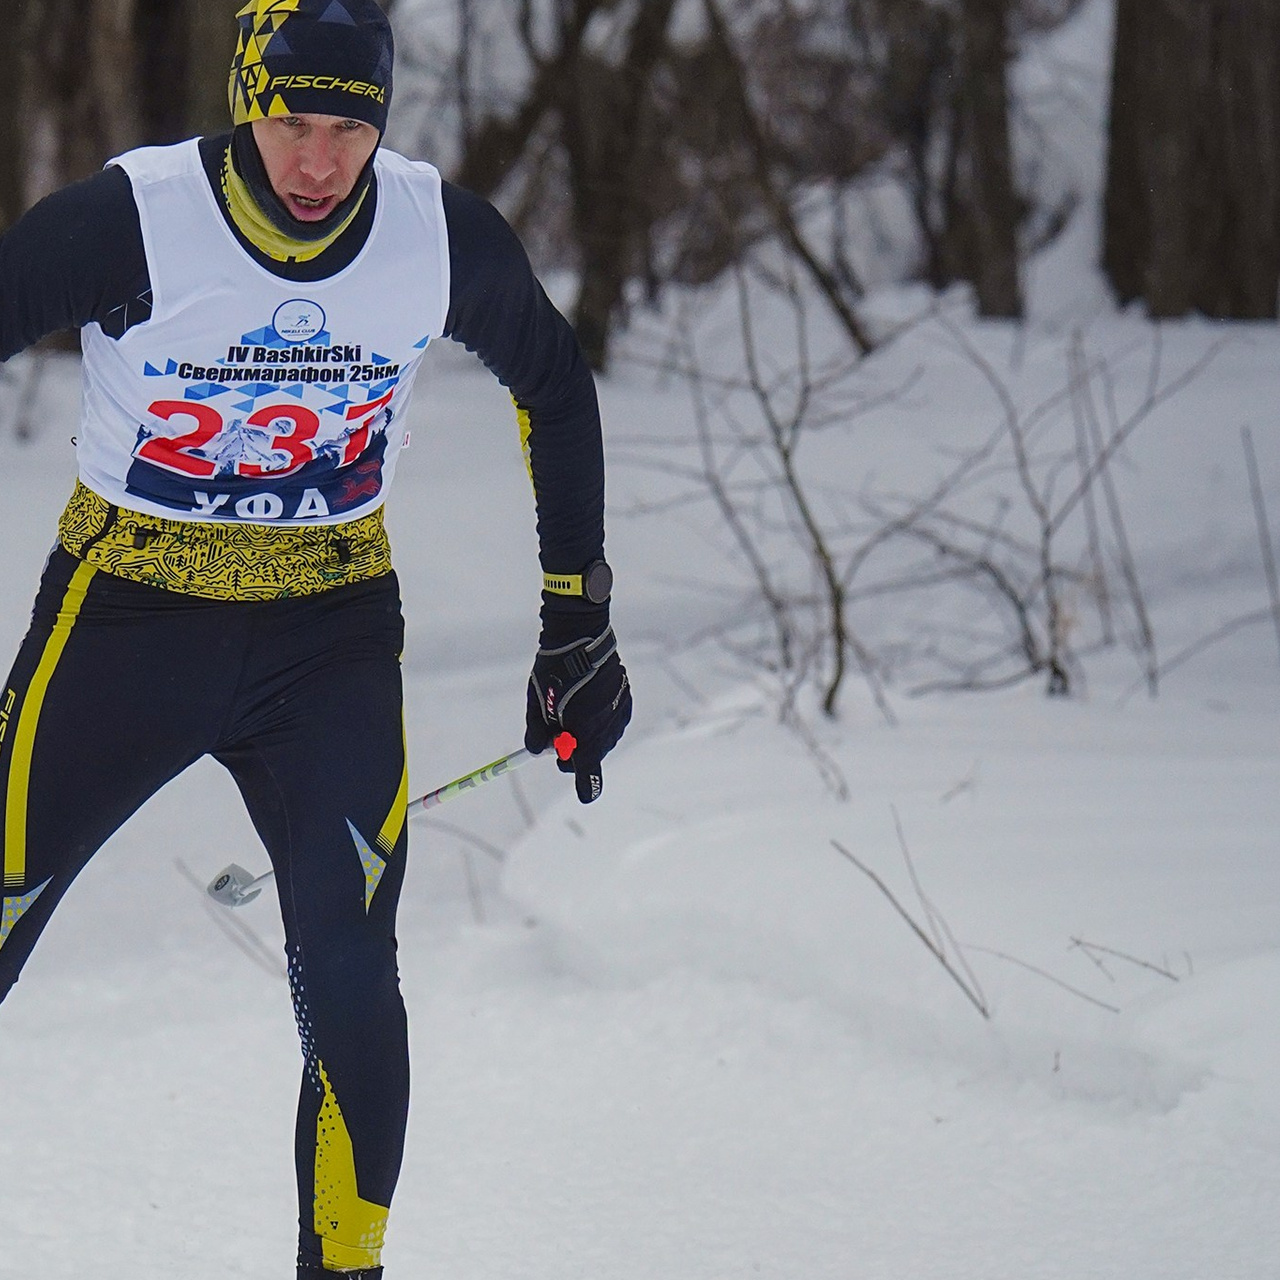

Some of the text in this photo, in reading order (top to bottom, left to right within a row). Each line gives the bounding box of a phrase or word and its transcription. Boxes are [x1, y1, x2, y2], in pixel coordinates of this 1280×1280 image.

[270, 75, 380, 101] FISCHER
[227, 345, 361, 363] IV BashkirSki
[178, 363, 400, 383] Сверхмарафон 25км
[134, 388, 395, 480] 237
[190, 488, 330, 519] УФА
